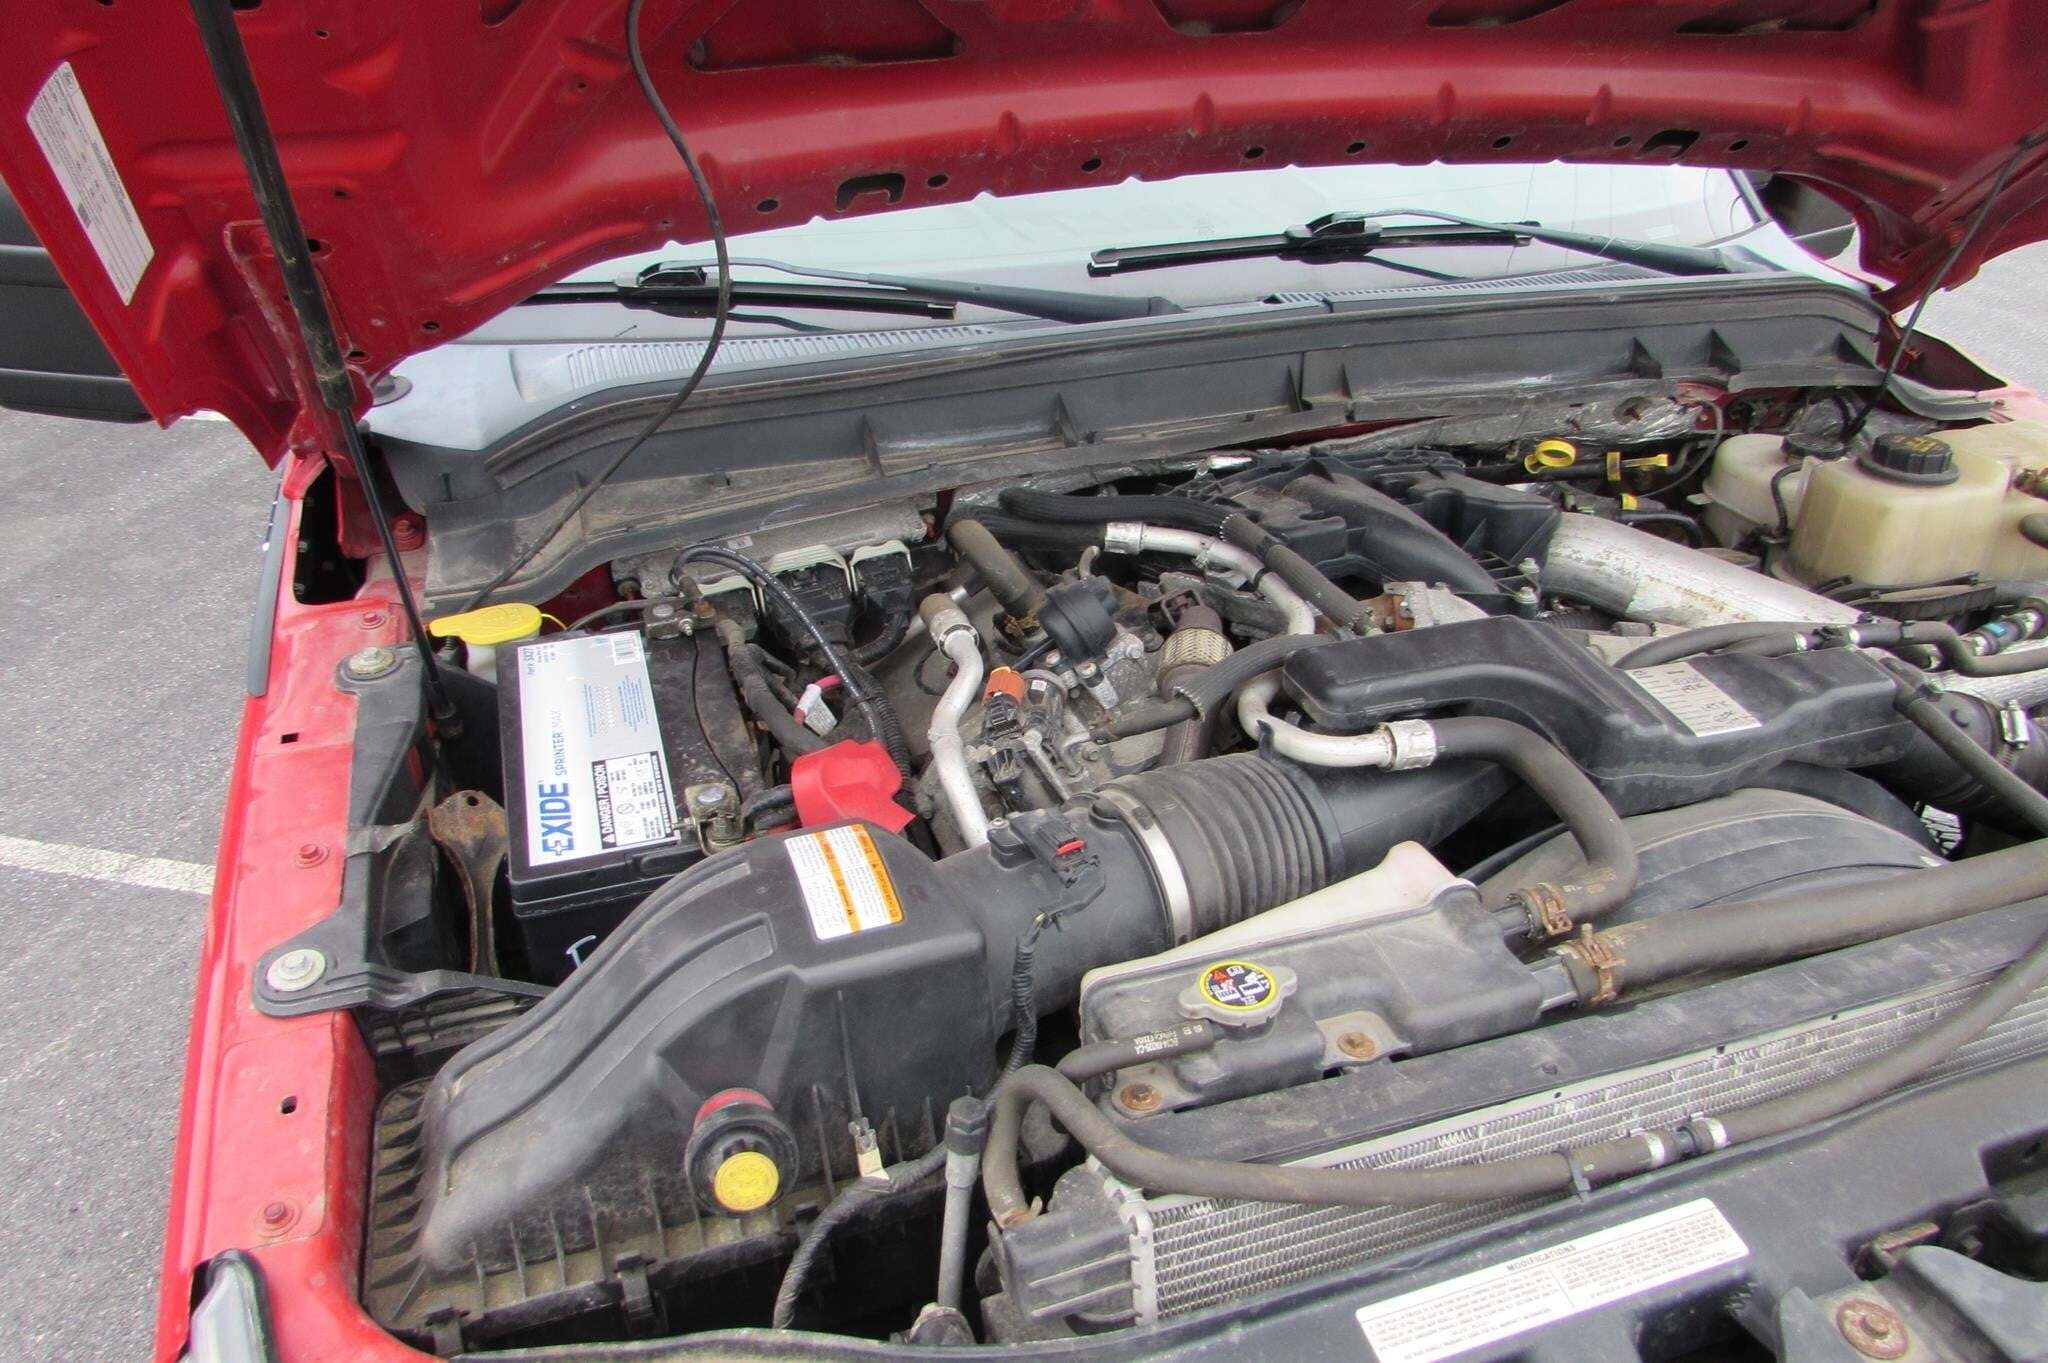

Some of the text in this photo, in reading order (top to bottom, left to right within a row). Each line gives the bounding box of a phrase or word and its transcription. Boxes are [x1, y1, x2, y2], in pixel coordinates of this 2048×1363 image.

[552, 732, 567, 776] SPRINTER
[594, 764, 608, 793] POISON
[539, 782, 575, 857] EXIDE
[599, 799, 612, 834] DANGER
